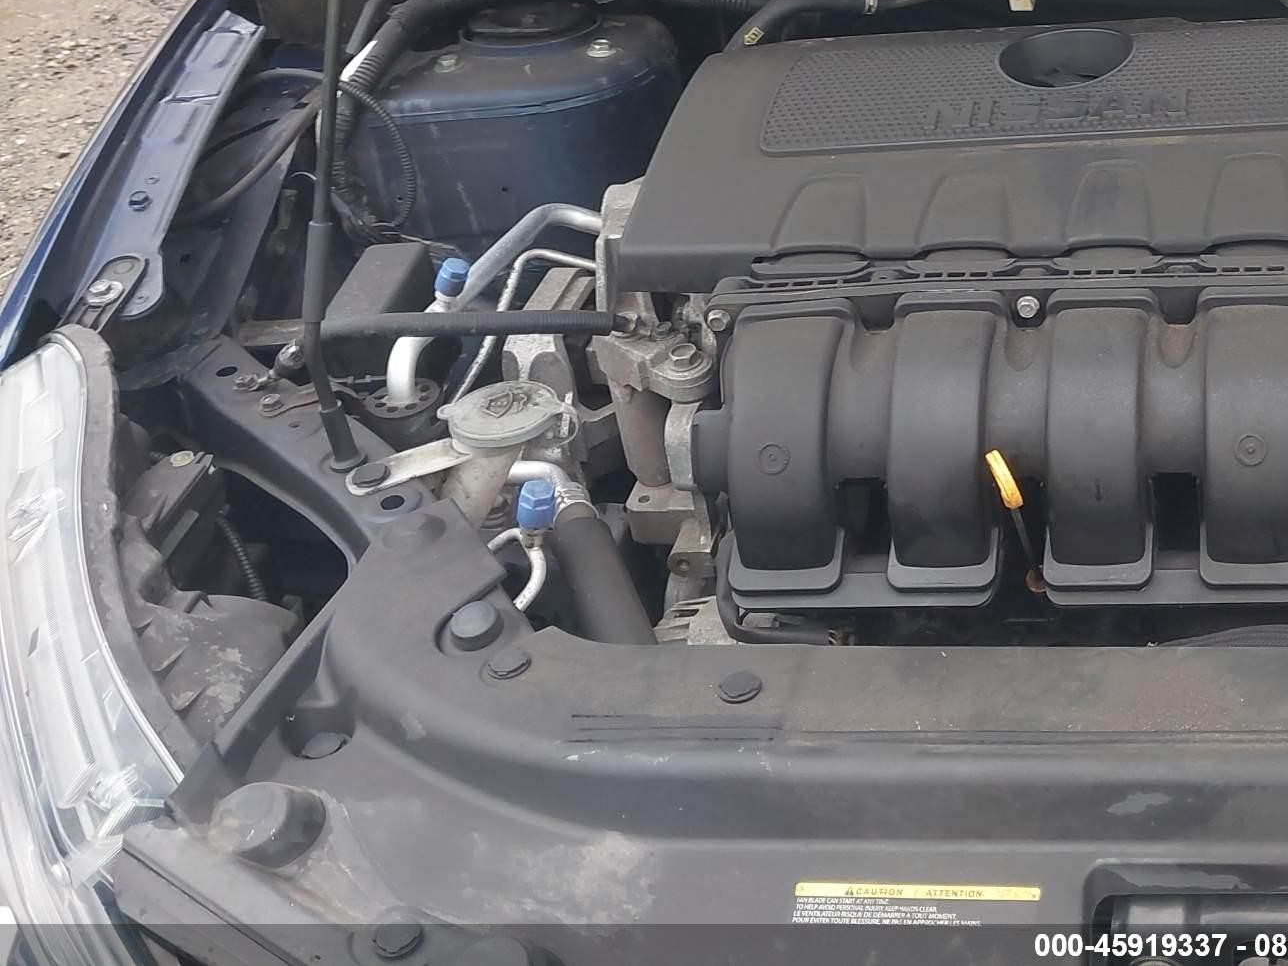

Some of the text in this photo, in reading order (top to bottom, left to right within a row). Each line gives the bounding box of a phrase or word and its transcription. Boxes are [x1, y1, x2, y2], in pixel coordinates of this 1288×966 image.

[922, 88, 1192, 132] NISSAN
[855, 887, 904, 897] CAUTION
[926, 889, 984, 899] ATTENTION
